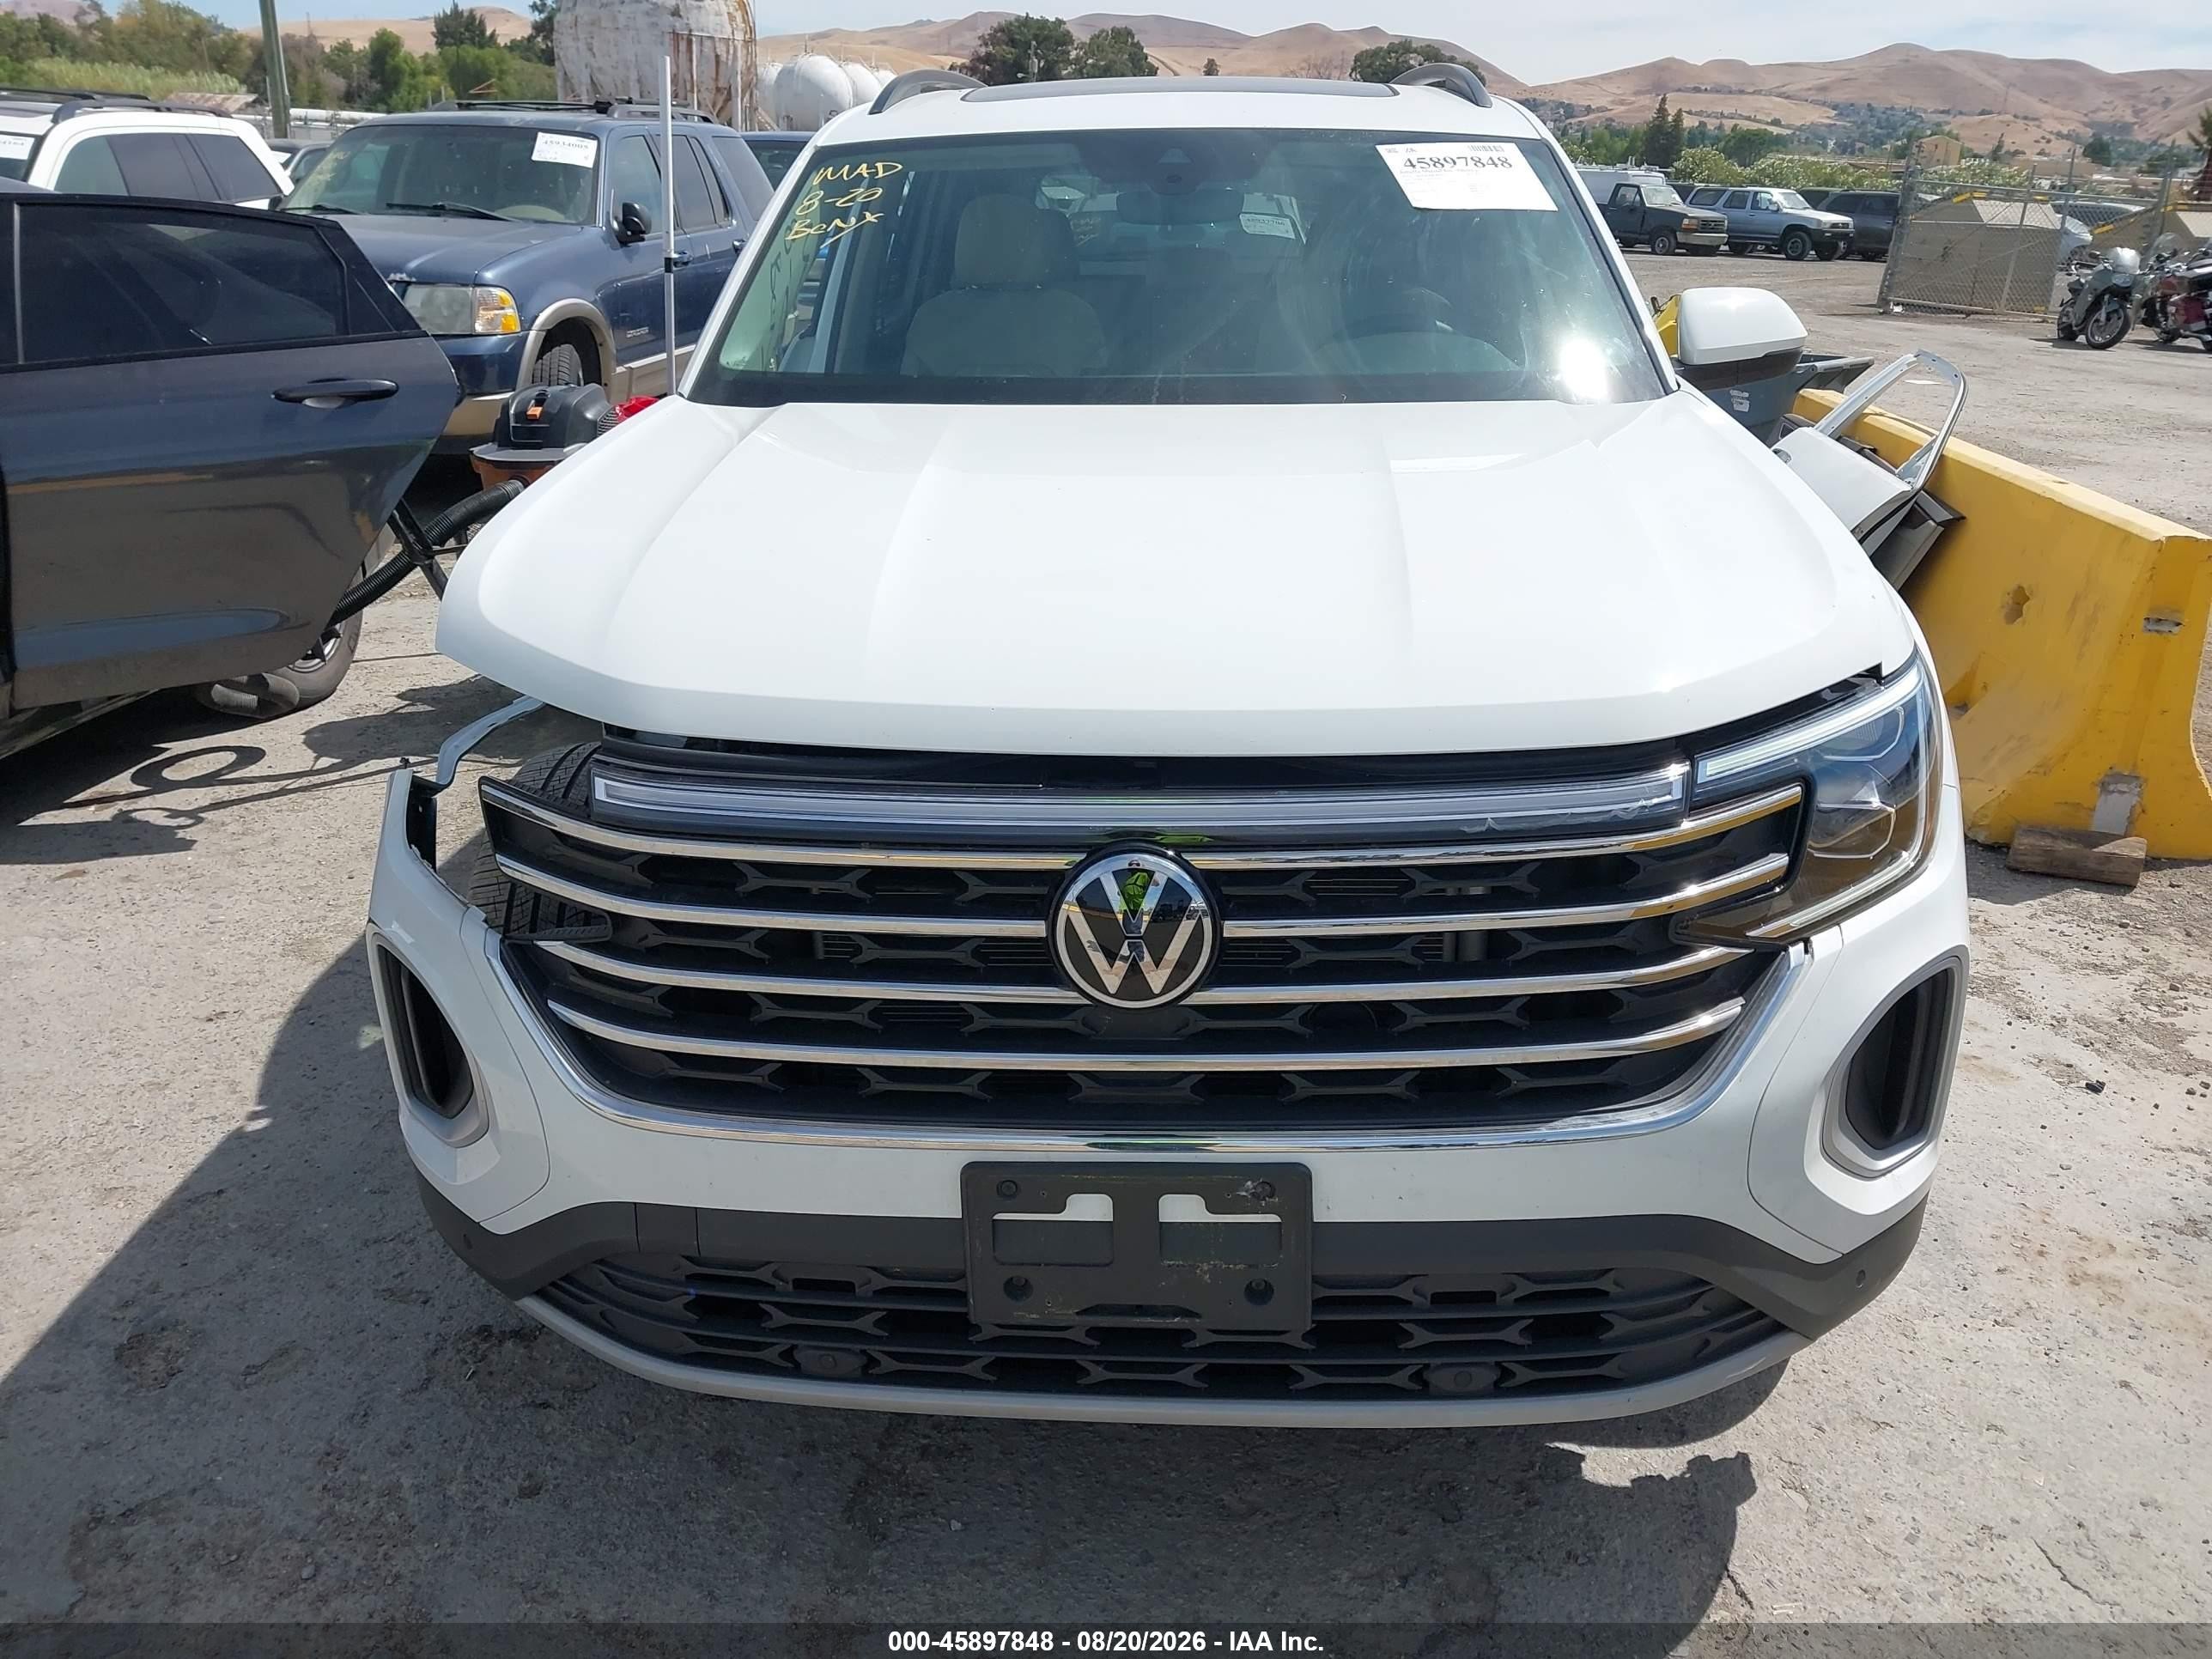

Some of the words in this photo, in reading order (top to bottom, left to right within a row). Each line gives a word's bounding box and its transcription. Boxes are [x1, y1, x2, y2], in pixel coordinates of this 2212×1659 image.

[812, 161, 902, 185] MAD
[1404, 156, 1513, 169] 45897848
[795, 186, 884, 216] 8-20
[1062, 870, 1203, 995] VW
